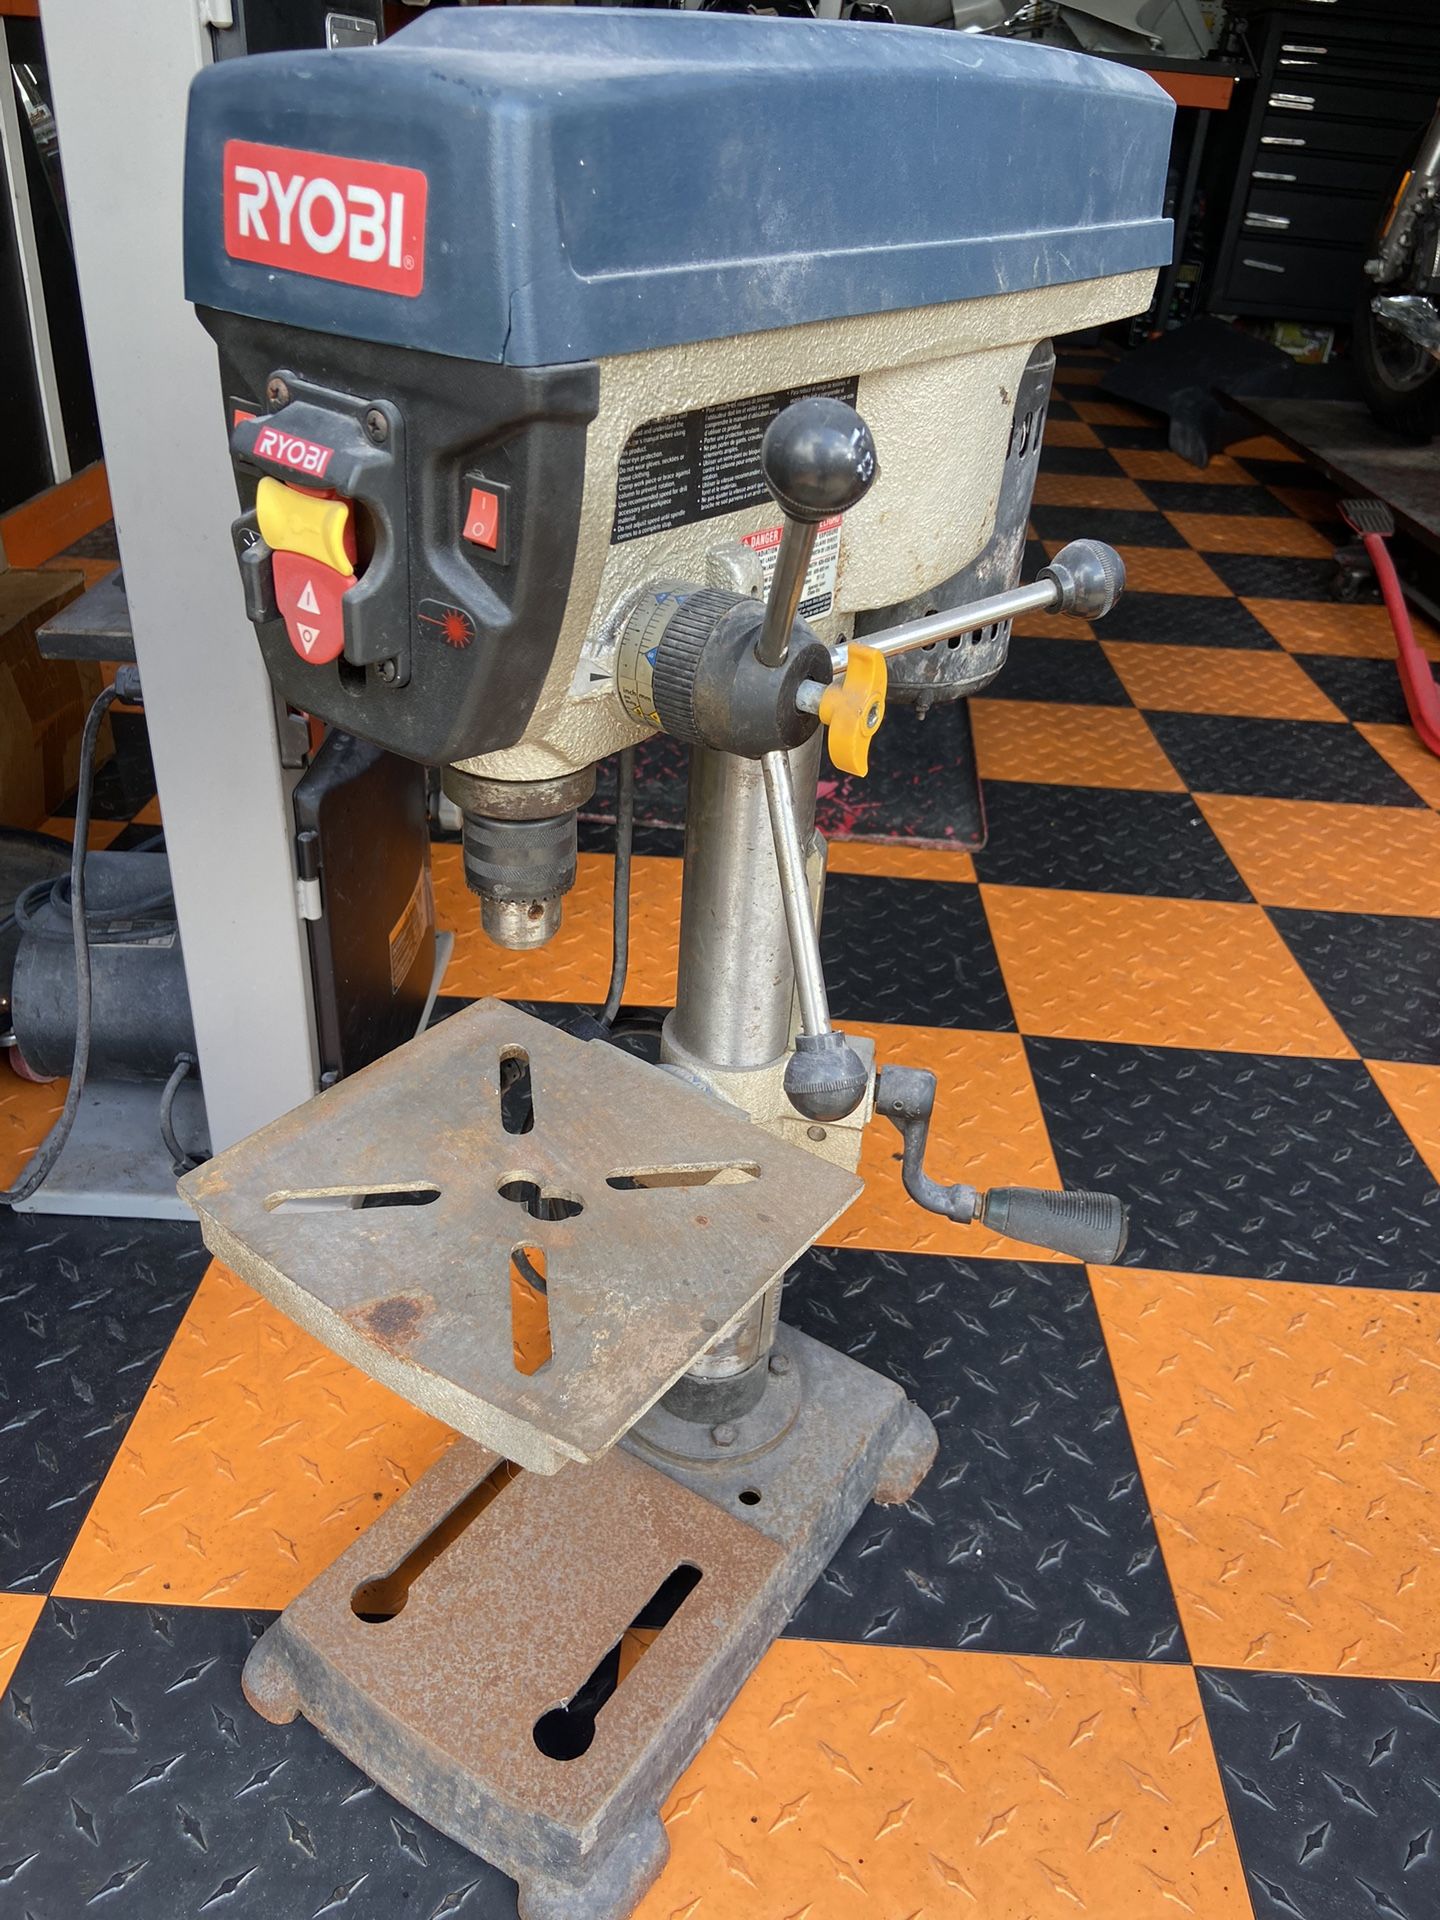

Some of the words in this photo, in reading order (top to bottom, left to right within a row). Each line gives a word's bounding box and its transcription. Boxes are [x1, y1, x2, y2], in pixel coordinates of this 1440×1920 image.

[235, 165, 405, 268] RYOBI
[259, 430, 329, 472] RYOBI
[751, 530, 778, 548] DANGER
